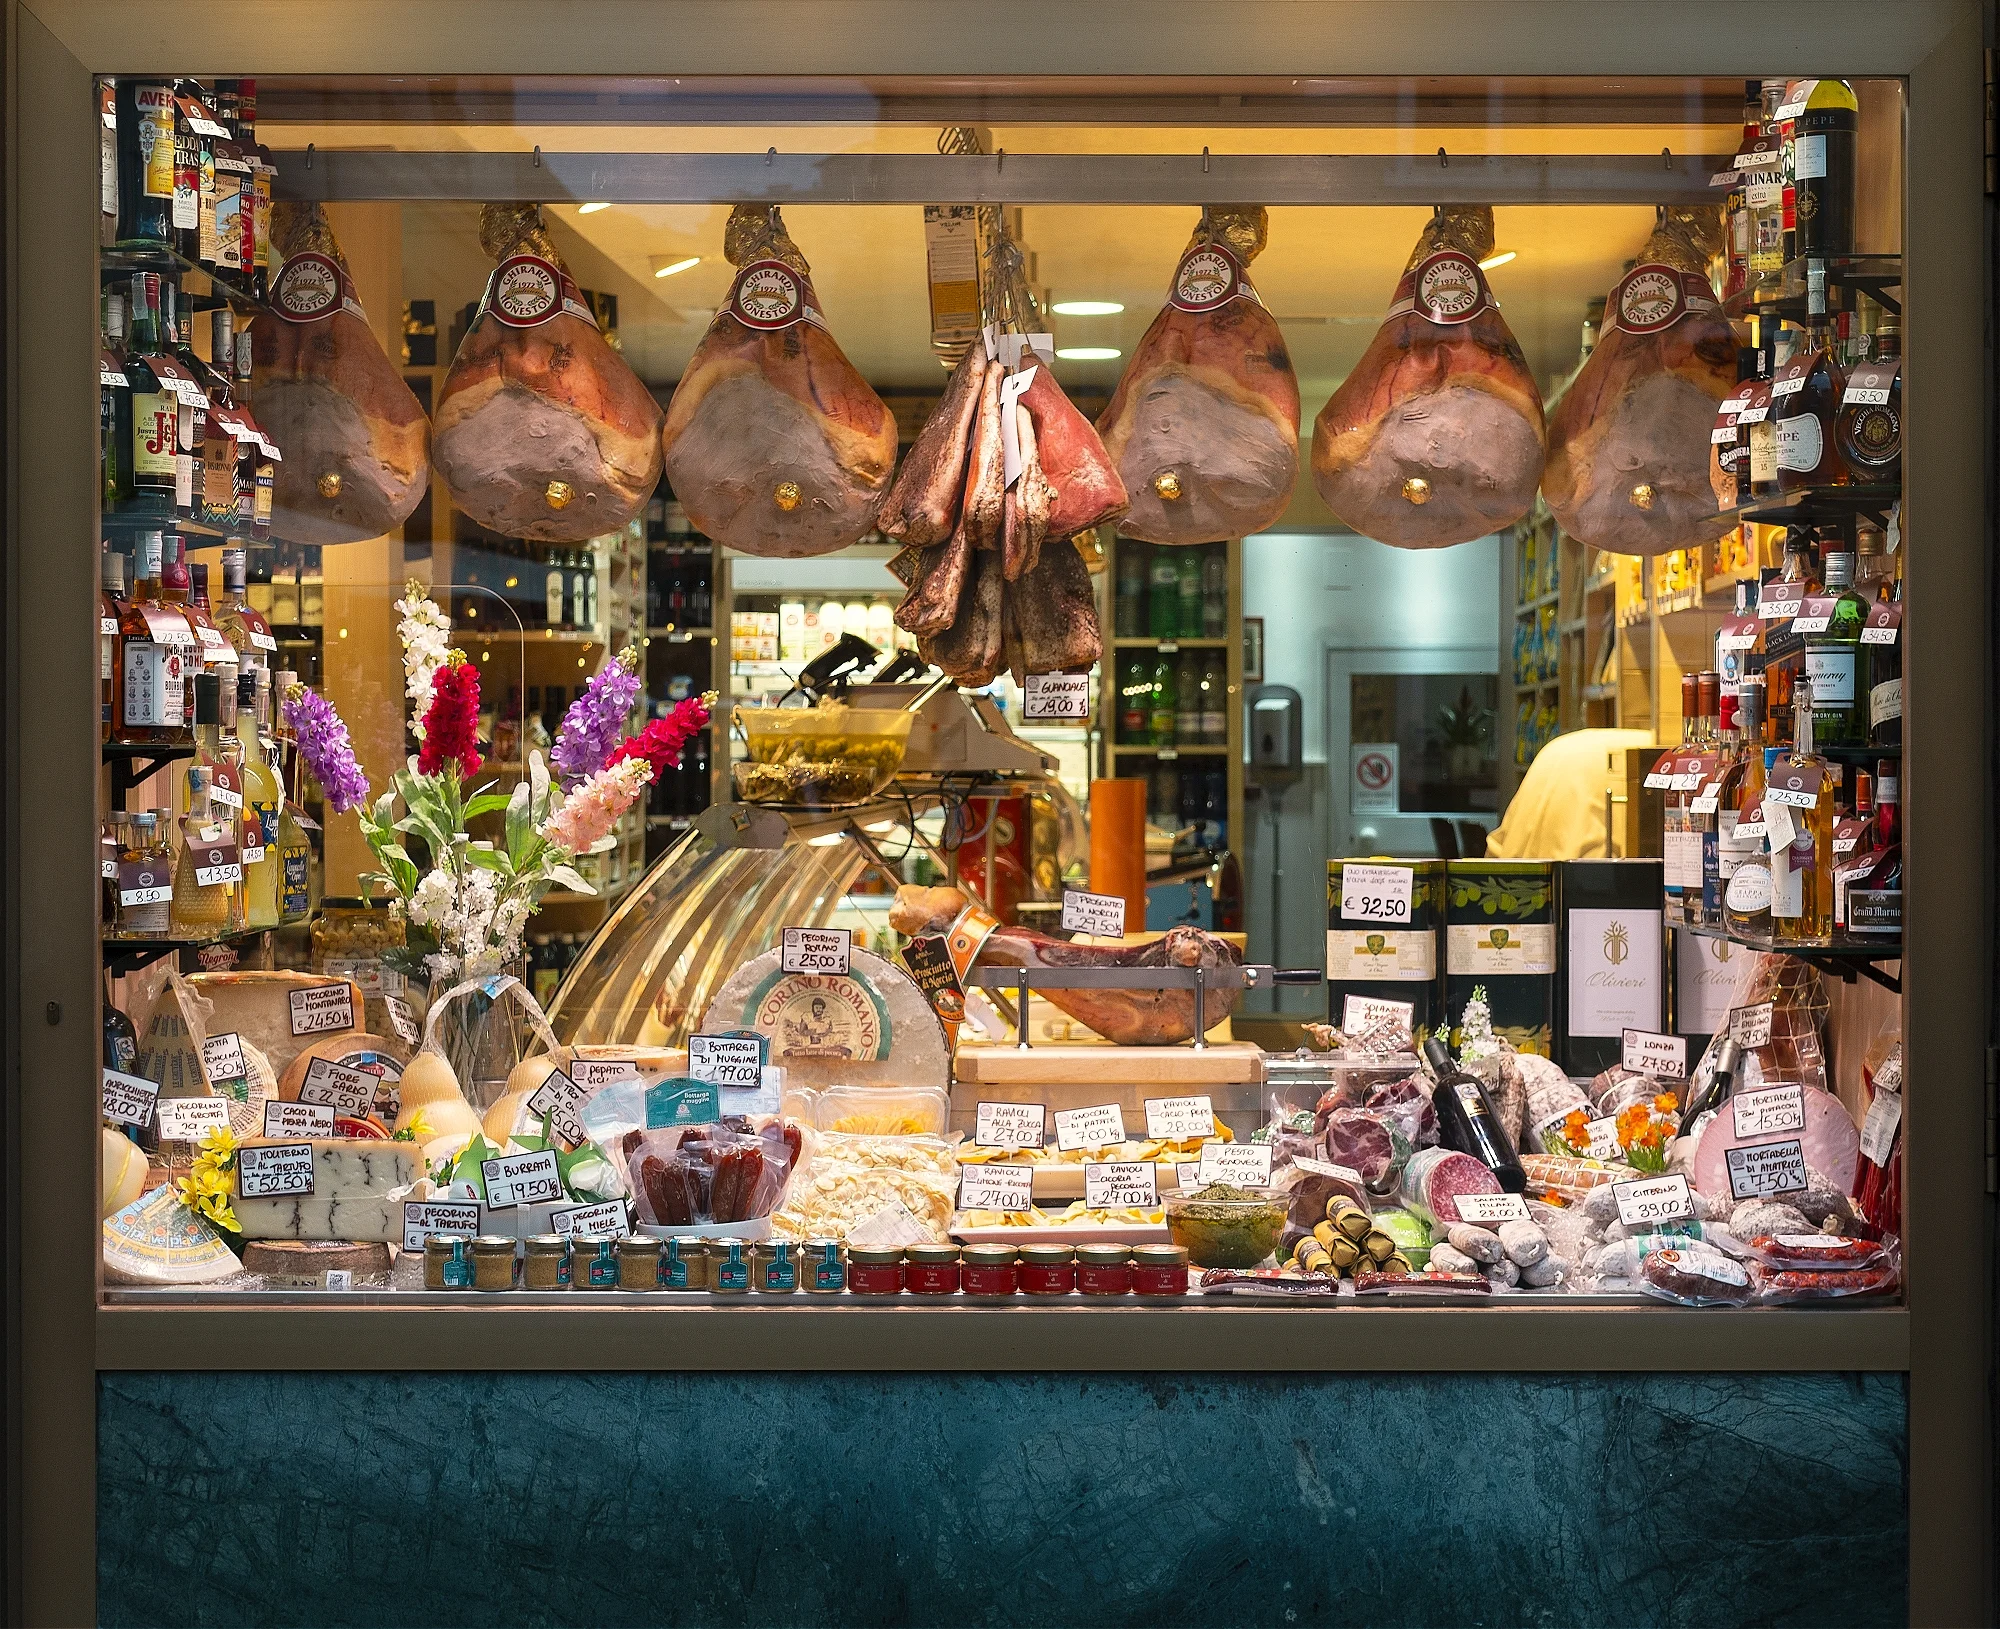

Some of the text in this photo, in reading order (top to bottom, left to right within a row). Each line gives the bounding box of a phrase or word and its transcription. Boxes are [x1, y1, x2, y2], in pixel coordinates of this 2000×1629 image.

[1805, 115, 1836, 126] PEPE
[1183, 254, 1229, 276] GHIRARDI
[285, 262, 333, 283] GHIRARDI
[503, 266, 552, 286] GHIRARDI
[1425, 262, 1474, 285] GHIRARDI
[518, 281, 535, 289] 1972
[745, 270, 794, 292] GHIRARDI
[1625, 274, 1673, 298] GHIRARDI
[760, 285, 778, 293] 1972
[1639, 289, 1657, 298] 1972
[1854, 389, 1883, 404] 18.50
[1854, 405, 1899, 436] VECCHIA ROMAGNA
[1767, 602, 1800, 615] 35,00
[1866, 631, 1893, 642] 34.50
[1041, 681, 1088, 693] GUANCIALE
[1037, 699, 1073, 715] 19,00
[1820, 712, 1843, 720] DRY GIN
[1774, 793, 1810, 805] 25.50
[206, 865, 239, 882] 13,50
[136, 889, 160, 903] 8.50
[1089, 908, 1119, 919] NORCIA
[1344, 896, 1406, 918] € 92,50
[1853, 906, 1873, 918] Grand
[801, 933, 841, 943] PECORINO
[804, 944, 838, 952] ROMANO
[198, 950, 239, 966] Negroni
[799, 953, 835, 969] 25,00
[914, 961, 951, 979] Prosciutto
[929, 972, 953, 988] Norcia
[1585, 971, 1647, 989] Olivieri
[306, 988, 344, 1001] PECORINO
[306, 997, 351, 1011] MONTANARO
[763, 977, 874, 1048] CORINO ROMANO
[304, 1012, 341, 1031] 24.50
[709, 1041, 755, 1052] BOTTARGA
[1644, 1040, 1674, 1051] LONZA
[701, 1054, 758, 1064] DI MUGGINE
[1640, 1055, 1676, 1072] 27,50
[327, 1069, 360, 1083] FIORE
[589, 1065, 625, 1077] PEPATO
[332, 1081, 368, 1096] SARDO
[684, 1091, 710, 1099] Bottarga
[319, 1089, 355, 1109] 22.50
[687, 1097, 710, 1105] muggine
[1164, 1098, 1196, 1109] RAVIOLI
[1753, 1091, 1802, 1106] MORTADELLA
[177, 1102, 223, 1111] PECORINO
[283, 1107, 316, 1116] CACIO DI
[996, 1107, 1029, 1118] RAVIOLI
[190, 1112, 224, 1120] GROTTA
[1072, 1109, 1110, 1120] GNOCCHI
[1754, 1112, 1793, 1129] 15.50
[310, 1118, 333, 1128] NERO
[991, 1119, 1041, 1128] ALLA ZUCCA
[1165, 1120, 1203, 1133] 28.00
[994, 1127, 1032, 1144] 27,00
[1076, 1129, 1106, 1143] 7.00
[260, 1148, 310, 1160] MOLITERNO
[1224, 1147, 1254, 1156] PESTO
[1746, 1146, 1799, 1162] MORTADELLA
[257, 1161, 311, 1173] AL TARTUFO
[504, 1159, 552, 1177] BURRATA
[1216, 1157, 1263, 1166] GENOVESE
[1746, 1159, 1802, 1173] DI AMATRICE
[984, 1167, 1021, 1176] RAVIOLI
[1110, 1166, 1143, 1174] RAVIOLI
[1213, 1168, 1256, 1182] 23.00
[259, 1175, 303, 1192] 52.50
[1100, 1175, 1131, 1183] CICORIA
[1750, 1172, 1789, 1192] 7.50
[511, 1179, 548, 1201] 19.50
[1111, 1182, 1152, 1191] PECORINO
[1633, 1185, 1678, 1198] CITTERINO
[425, 1207, 477, 1219] PECORINO
[573, 1206, 618, 1224] PECORINO
[1639, 1200, 1679, 1217] 39,00
[419, 1219, 477, 1230] AL TARTUFO
[572, 1217, 616, 1234] AL MIELE
[130, 1229, 166, 1245] piave
[170, 1234, 203, 1248] piave
